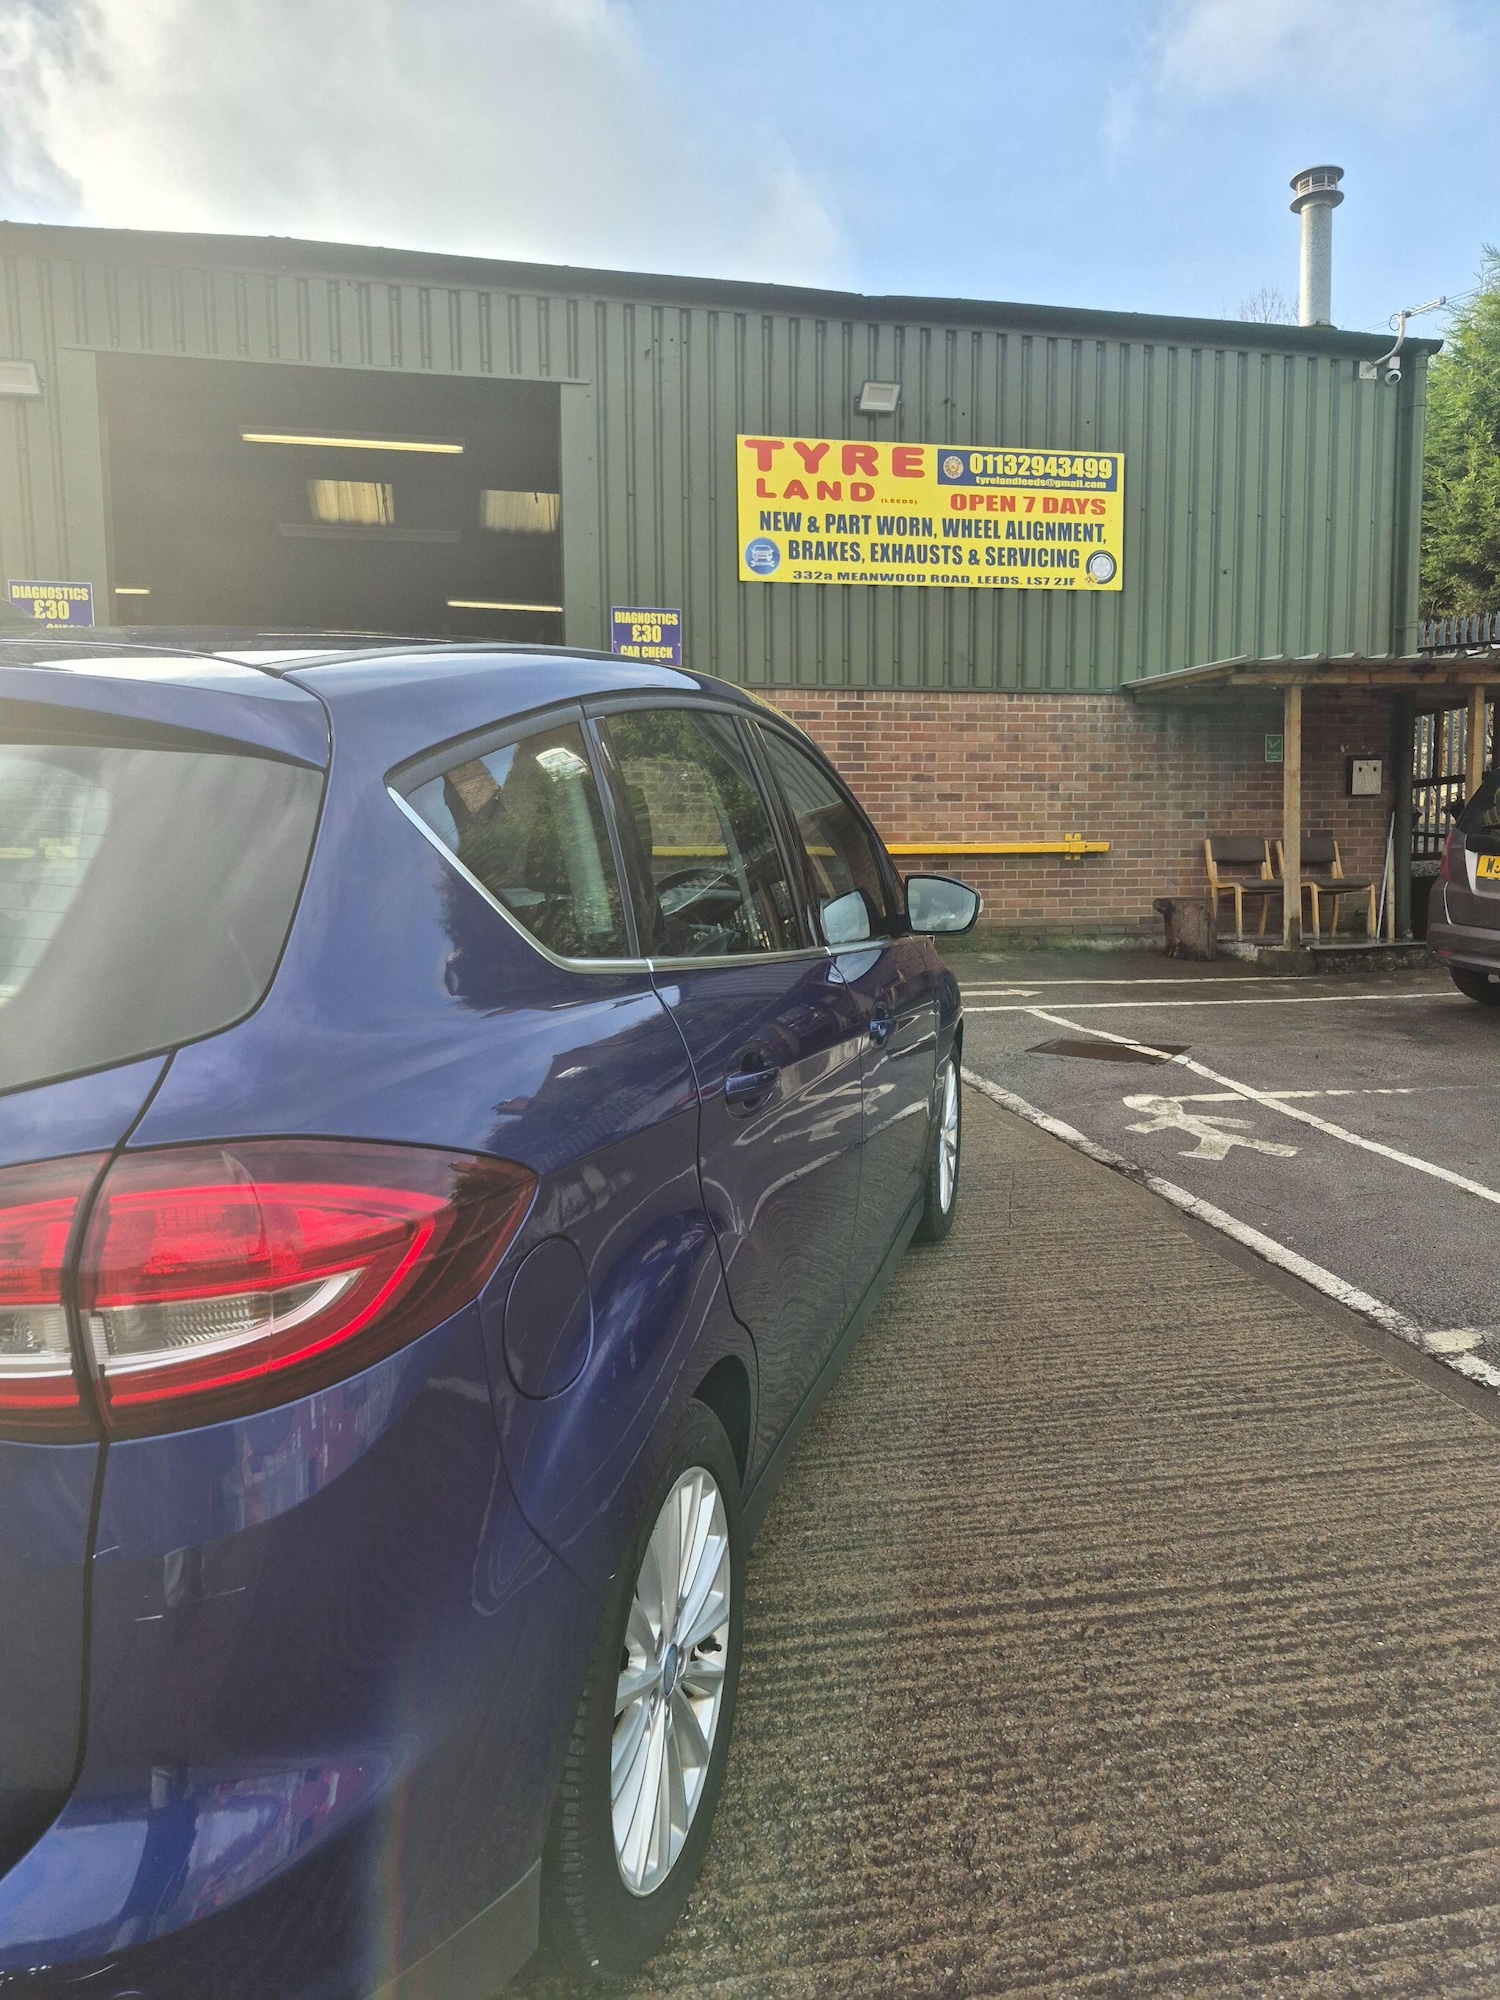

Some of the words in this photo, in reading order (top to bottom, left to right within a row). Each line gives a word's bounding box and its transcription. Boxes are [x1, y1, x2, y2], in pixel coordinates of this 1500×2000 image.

[744, 439, 926, 478] TYRE
[969, 453, 1112, 479] 01132943499
[756, 477, 875, 502] LAND
[976, 476, 1106, 489] tyrelandleeds@gmail.com
[950, 493, 1016, 513] OPEN
[1023, 496, 1036, 513] 7
[1042, 497, 1106, 516] DAYS
[759, 511, 802, 532] NEW
[807, 516, 820, 533] &
[825, 513, 871, 535] PART
[876, 516, 937, 539] WORN,
[942, 518, 1000, 540] WHEEL
[1005, 520, 1107, 544] ALIGNMENT,
[788, 540, 865, 564] BRAKES,
[870, 543, 963, 566] EXHAUSTS
[968, 549, 980, 566] &
[985, 546, 1080, 569] SERVICING
[837, 571, 925, 582] MEANWOOD
[1027, 577, 1050, 586] LS7
[1053, 577, 1076, 586] 2JF
[12, 585, 88, 600] DIAGNOSTICS
[33, 599, 69, 619] £30
[614, 611, 678, 625] DIAGNOSTICS
[631, 624, 661, 642] £30
[620, 645, 640, 658] CAR
[641, 646, 673, 658] CHECK
